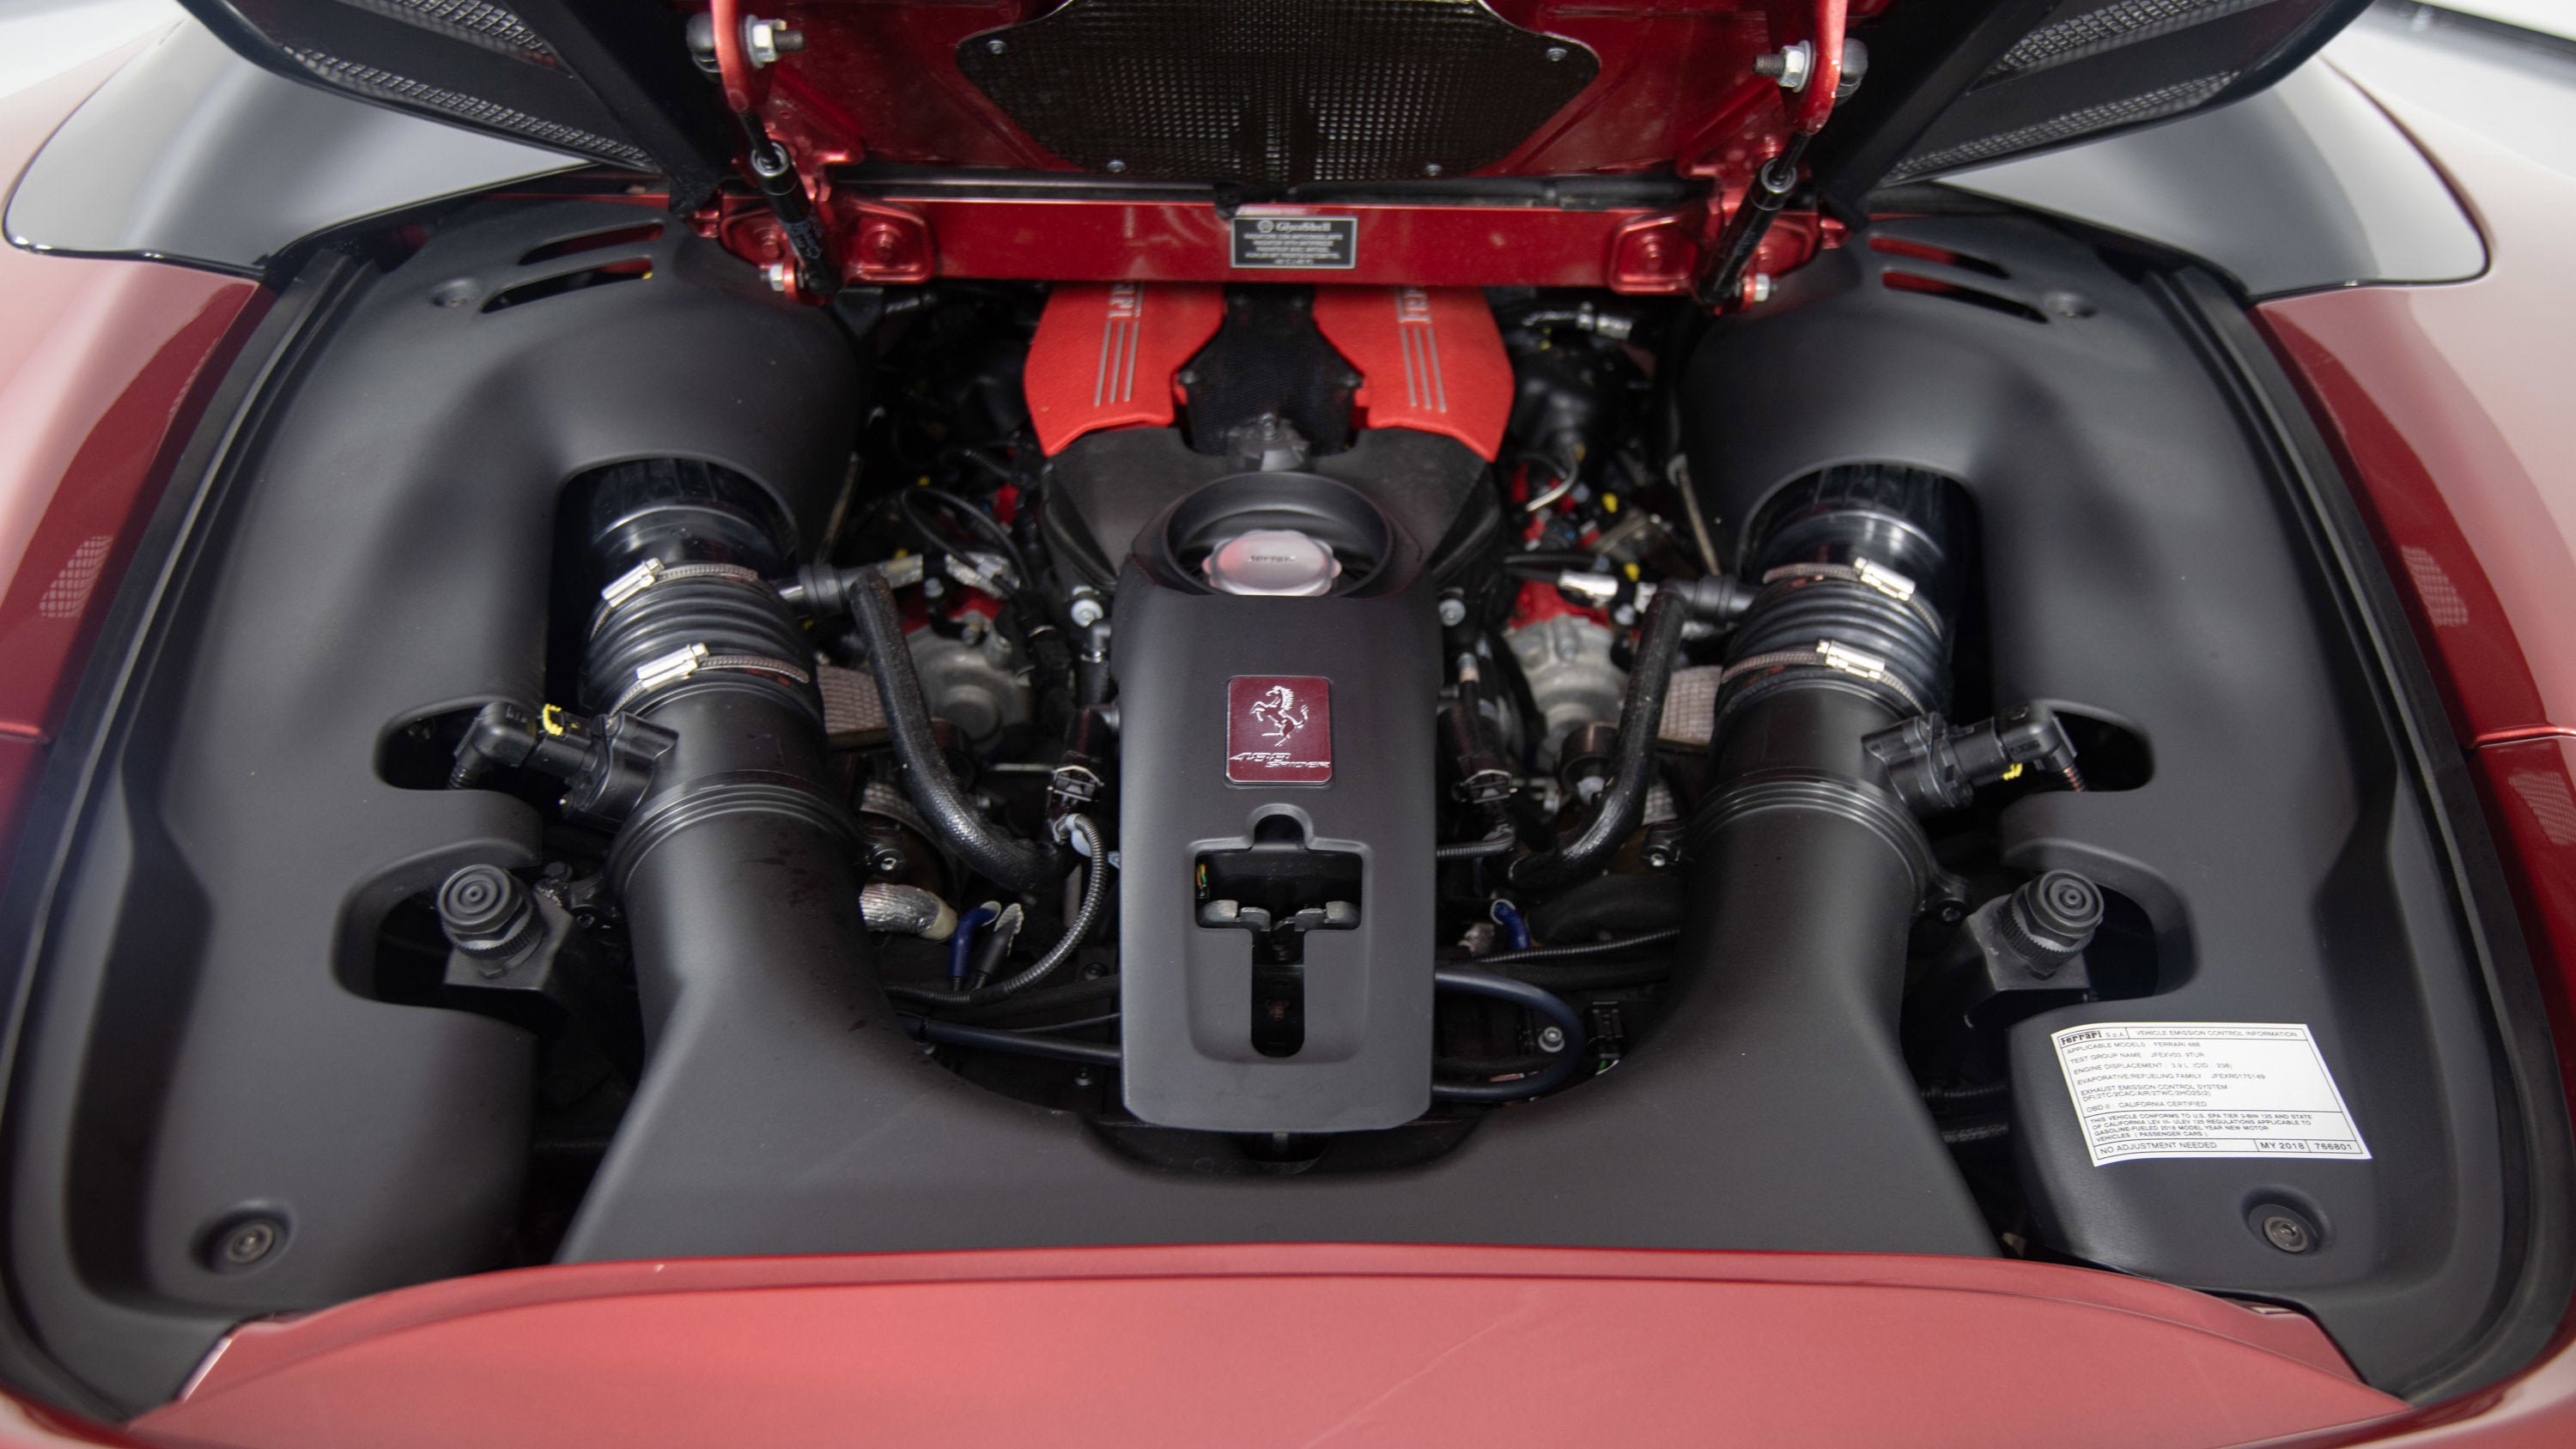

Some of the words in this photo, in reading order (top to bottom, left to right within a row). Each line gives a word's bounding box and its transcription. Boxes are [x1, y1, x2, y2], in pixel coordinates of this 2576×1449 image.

[2060, 1030, 2102, 1046] Ferrari
[2067, 1041, 2113, 1054] APPLICABLE
[2070, 1056, 2088, 1064] TEST
[2074, 1064, 2103, 1075] ENGINE
[2081, 1085, 2116, 1096] EXHAUST
[2087, 1104, 2104, 1113] OBD
[2103, 1119, 2147, 1128] CALIFORNIA
[2096, 1132, 2131, 1143] VEHICLES
[2099, 1146, 2114, 1155] NO
[2117, 1143, 2177, 1151] ADJUSTMENT
